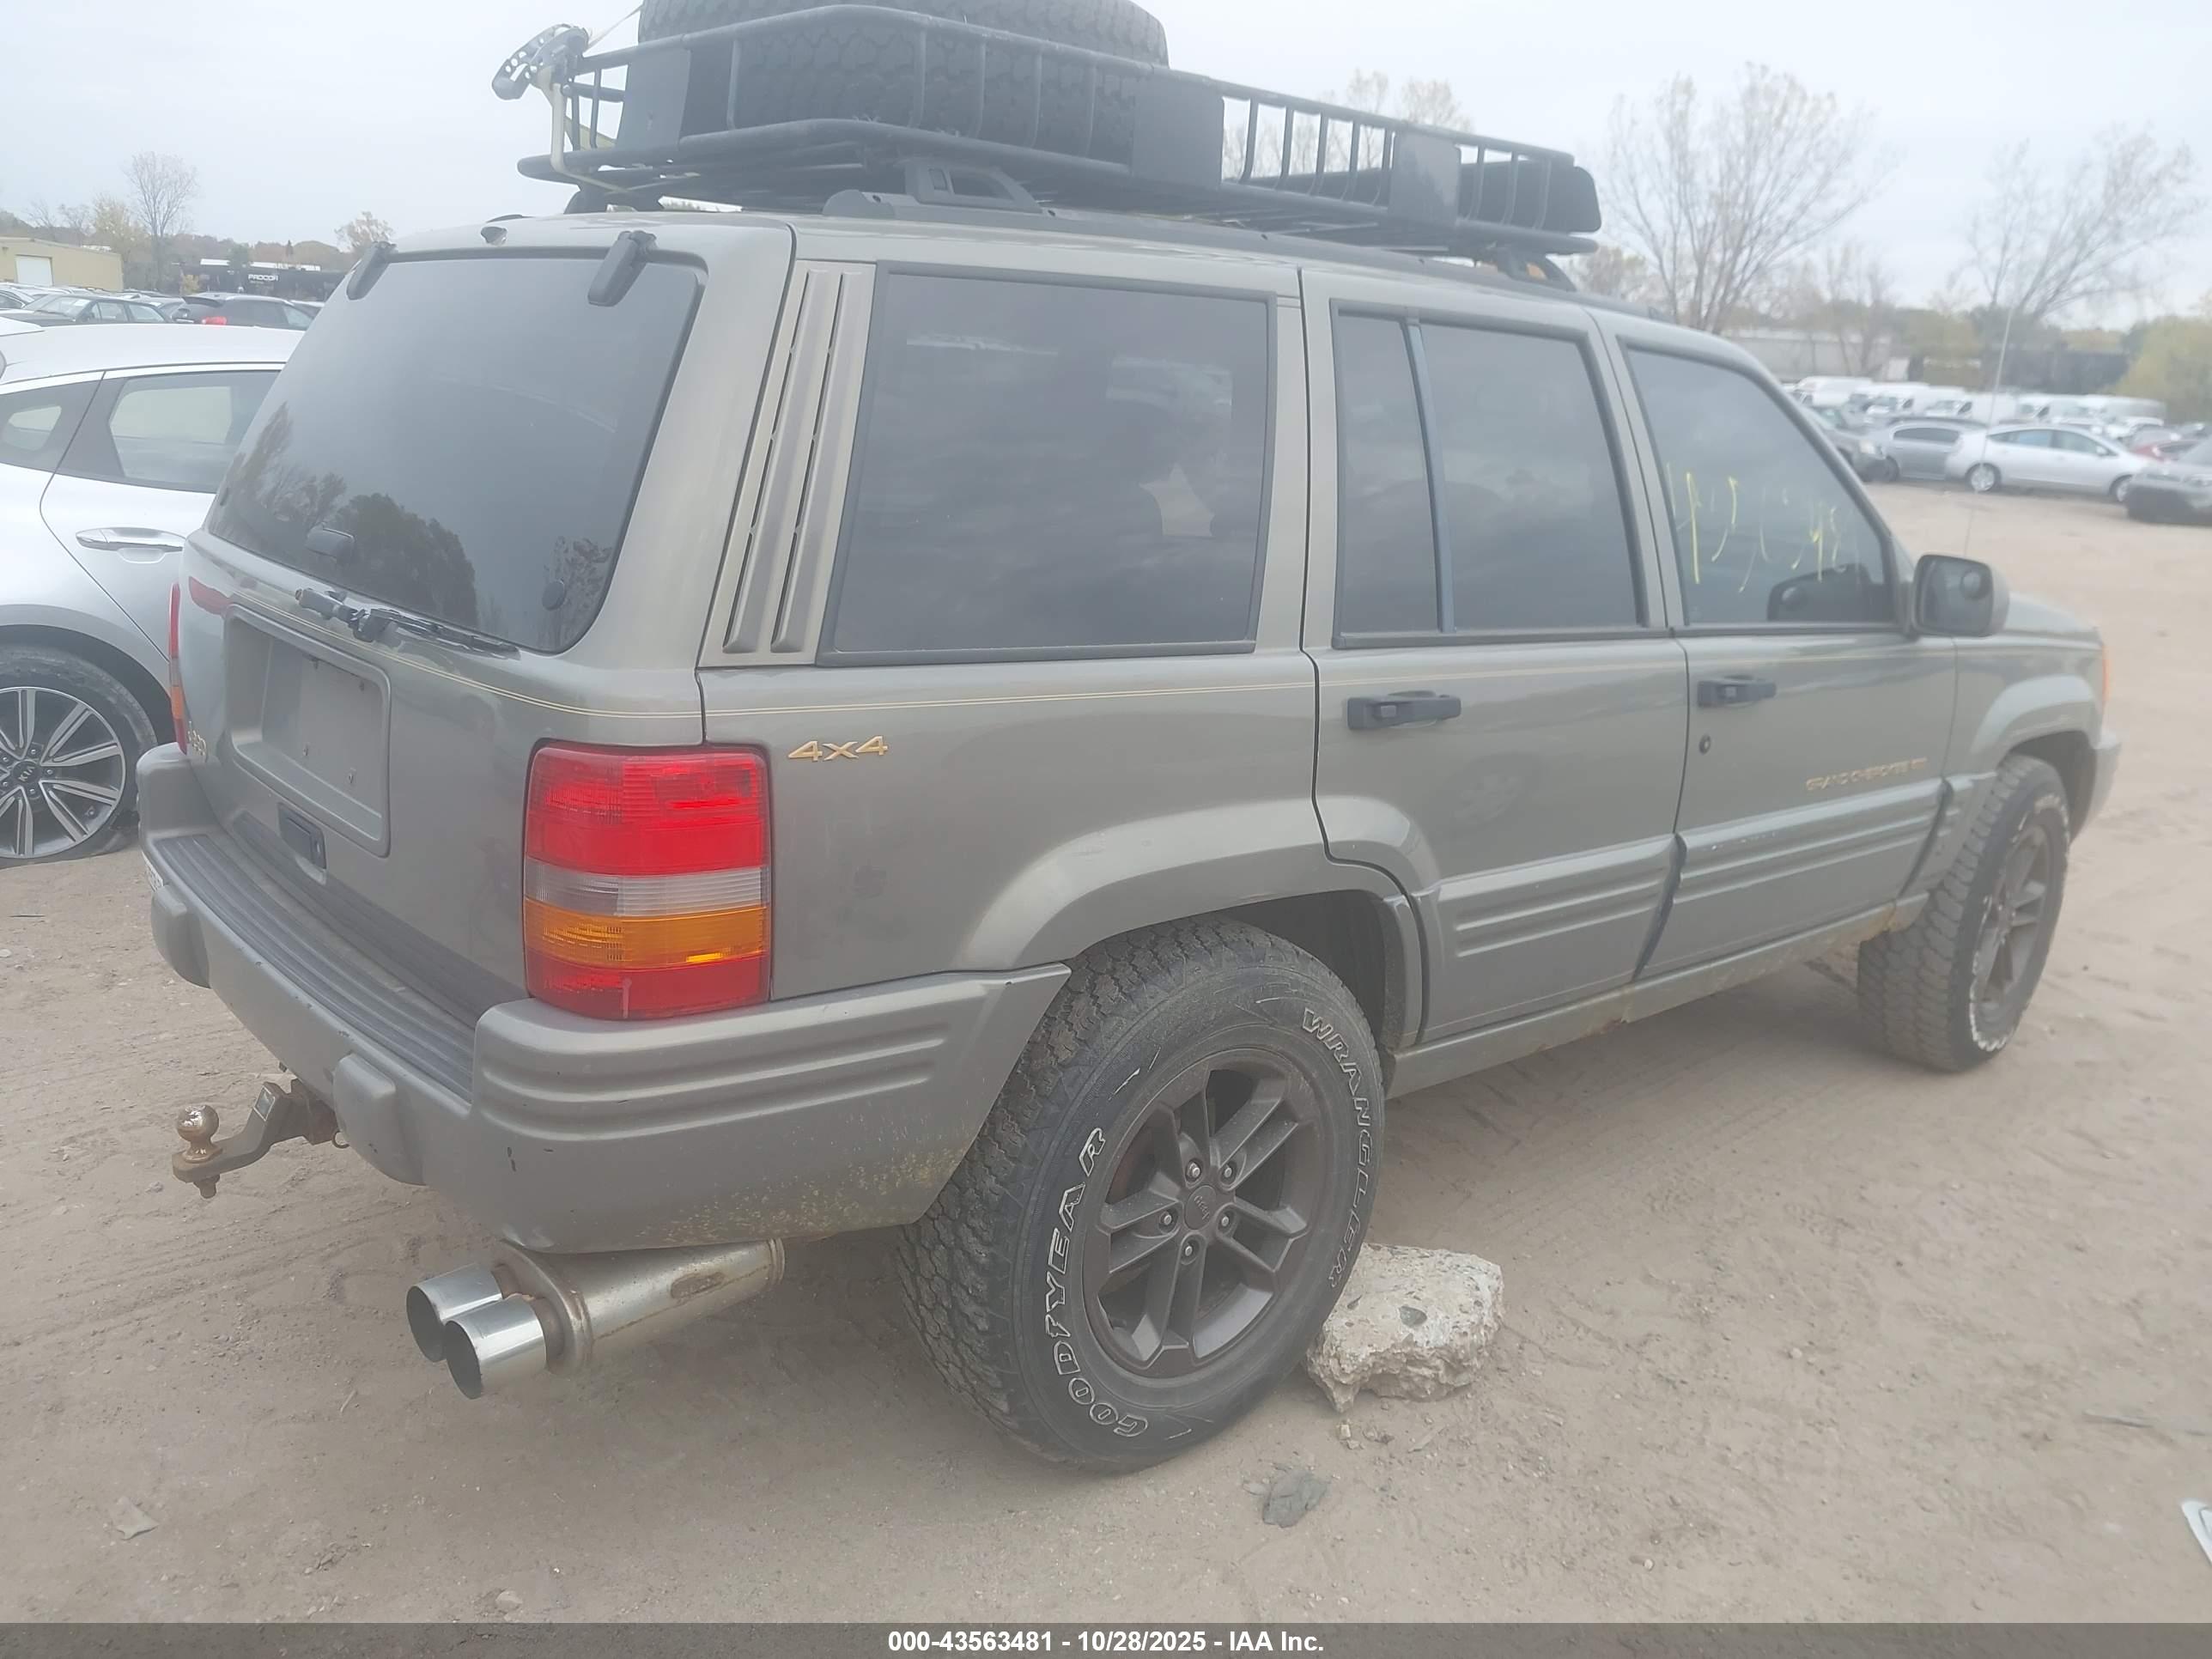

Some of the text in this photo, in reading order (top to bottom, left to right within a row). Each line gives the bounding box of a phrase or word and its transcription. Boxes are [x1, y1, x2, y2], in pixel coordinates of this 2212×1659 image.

[787, 735, 889, 763] 4x4
[1045, 1127, 1149, 1437] GOODYEAR
[1302, 1007, 1373, 1287] WRANGLER
